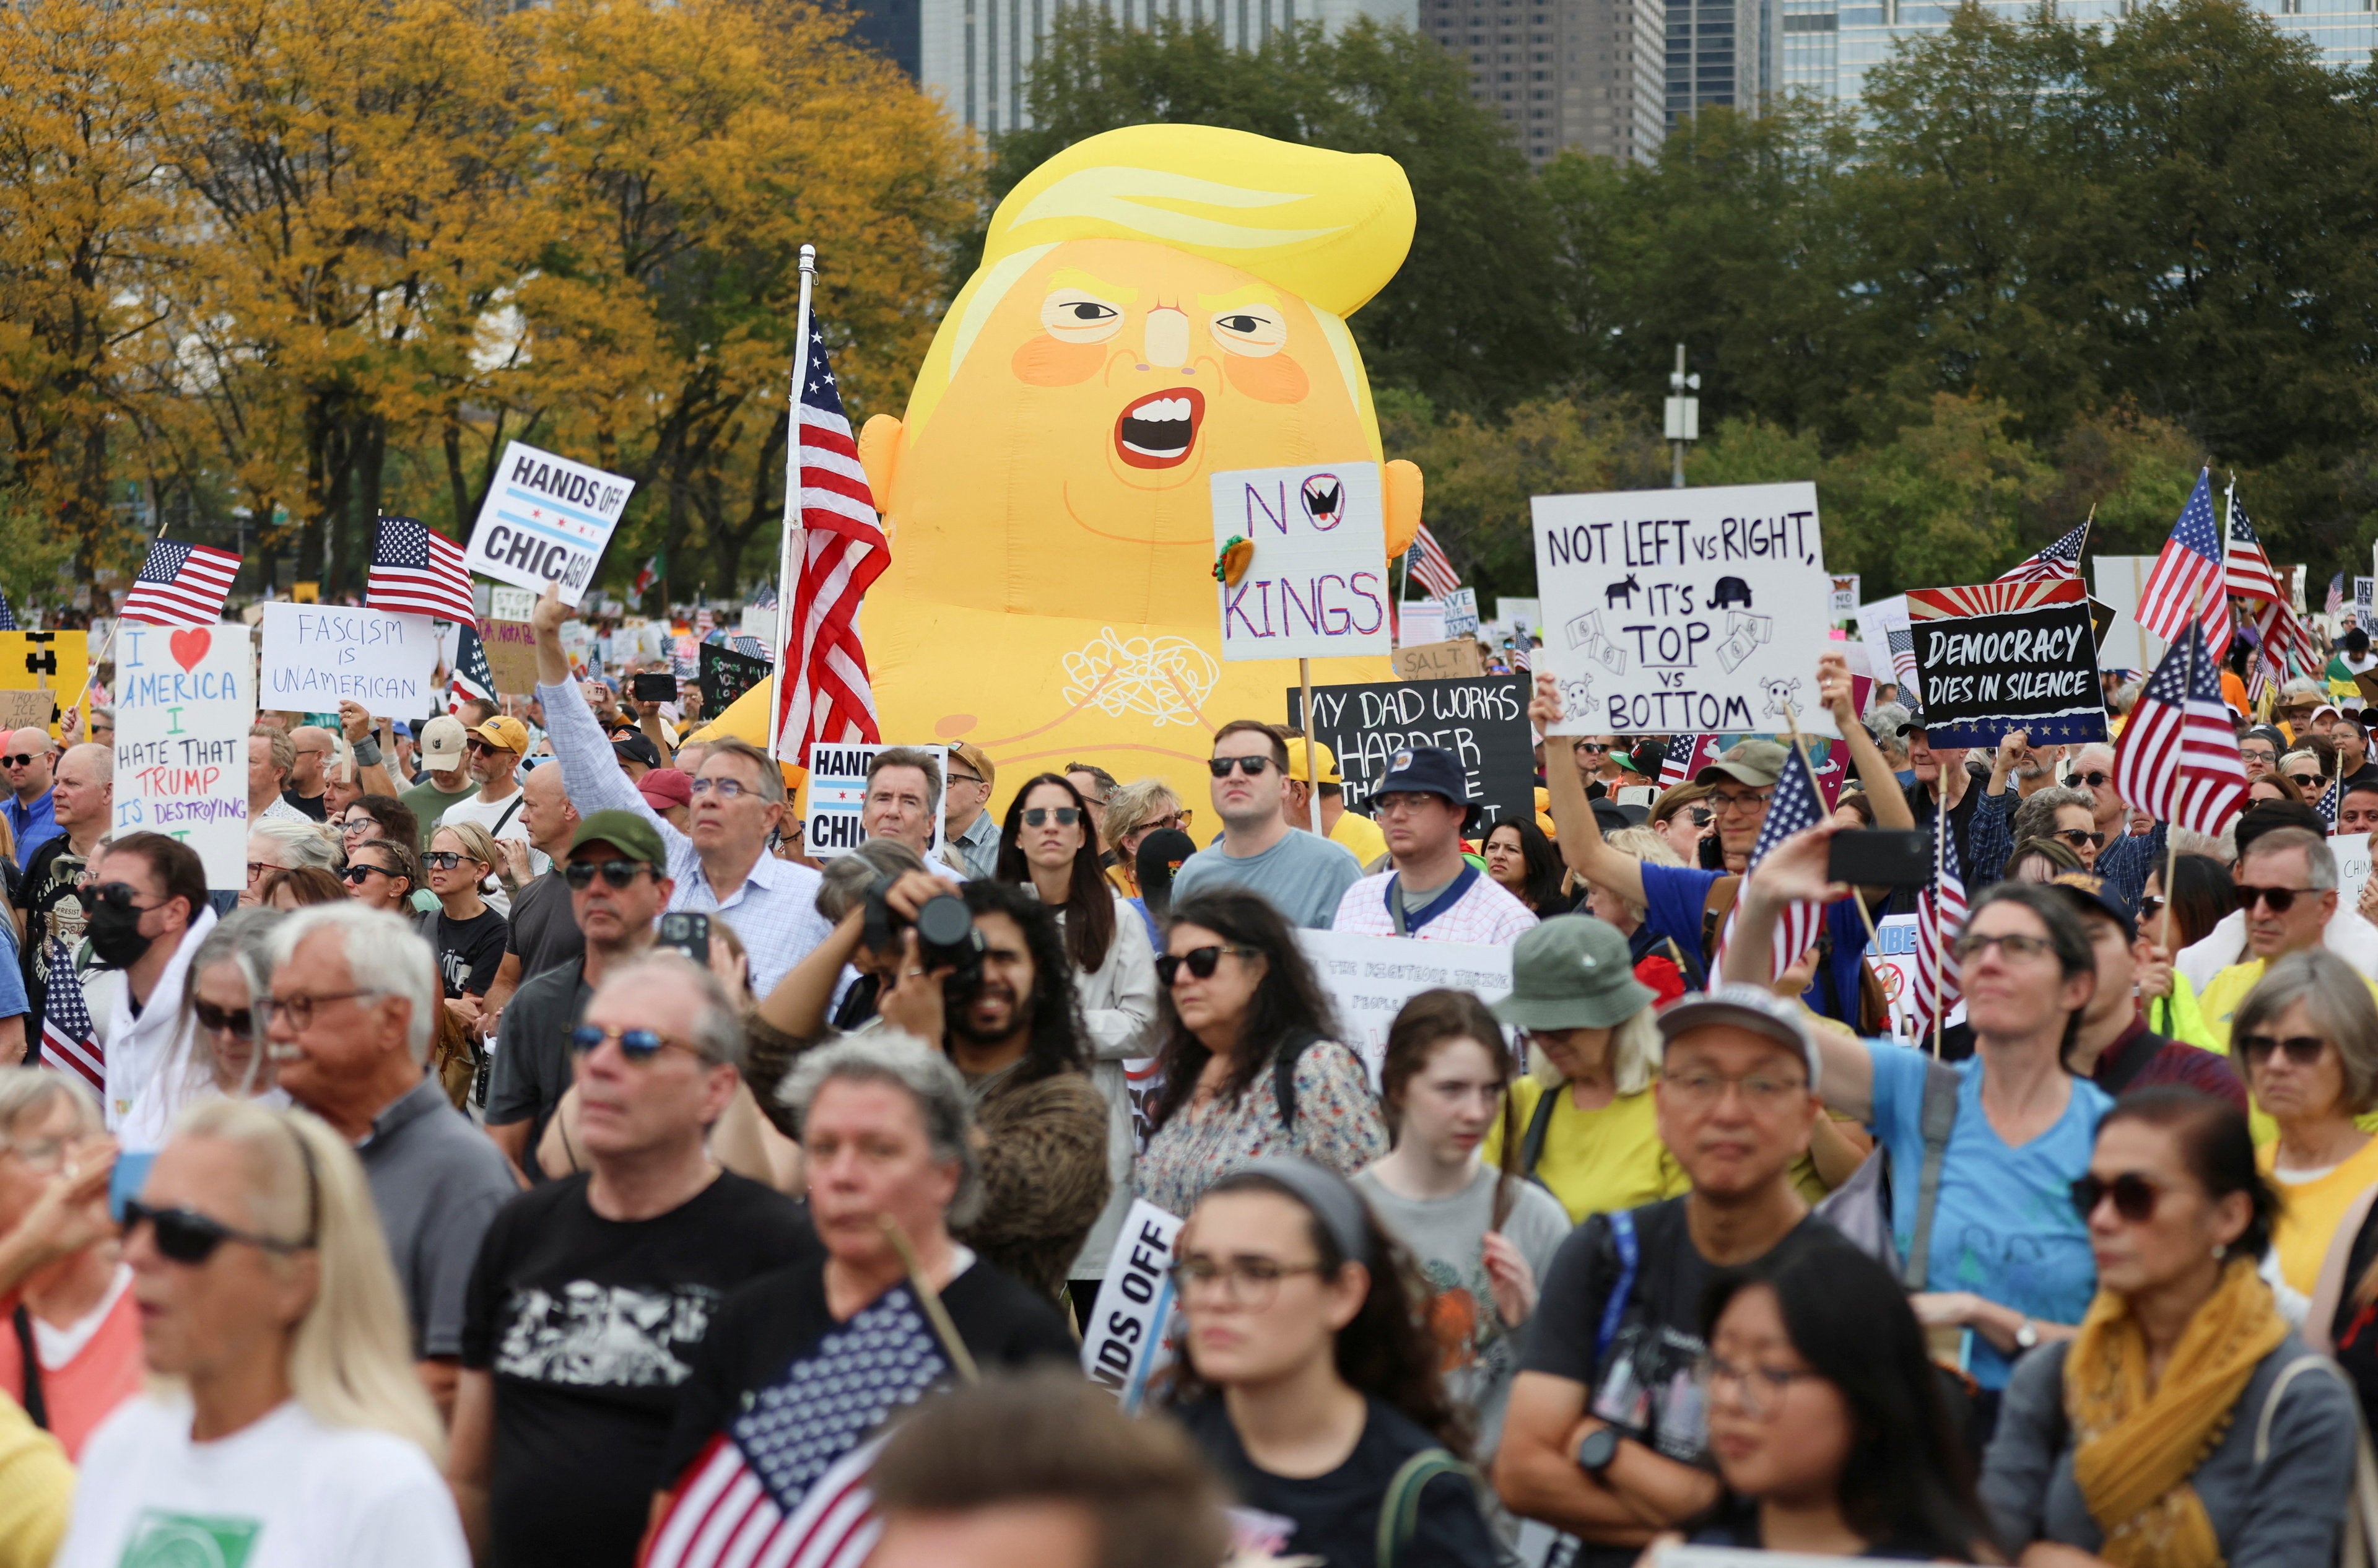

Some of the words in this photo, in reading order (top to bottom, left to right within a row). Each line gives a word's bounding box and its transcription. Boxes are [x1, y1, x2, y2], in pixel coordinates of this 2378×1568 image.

[511, 455, 600, 508] HANDS
[599, 486, 624, 516] OFF
[1245, 473, 1345, 538] NO
[485, 525, 592, 589] CHICAGO
[1548, 523, 1613, 566] NOT
[1624, 520, 1691, 567] LEFT
[1722, 512, 1815, 566] RIGHT,
[1225, 572, 1383, 640] KINGS
[1648, 583, 1694, 616] IT'S
[298, 614, 403, 645] FASCISM
[1622, 622, 1710, 665] TOP
[1923, 624, 2083, 669] DEMOCRACY
[126, 632, 146, 667] I
[339, 647, 355, 665] IS
[120, 672, 237, 708] AMERICA
[273, 665, 416, 699] UNAMERICAN
[1928, 675, 1975, 706] DIES
[1978, 673, 2001, 702] IN
[2004, 669, 2090, 702] SILENCE
[12, 705, 36, 716] ICE
[167, 707, 186, 734] I
[1299, 692, 1347, 731] MY
[1359, 688, 1425, 729] DAD
[1433, 685, 1520, 721] WORKS
[1608, 691, 1753, 729] BOTTOM
[119, 739, 169, 769] HATE
[178, 739, 237, 765] THAT
[136, 766, 220, 797] TRUMP
[118, 798, 143, 828] IS
[154, 797, 246, 824] DESTROYING
[56, 907, 80, 916] #RESIST
[1330, 960, 1357, 976] THE
[1365, 962, 1448, 984] RIGHTEOUS
[1455, 969, 1509, 990] THRIVE
[1352, 995, 1400, 1012] PEOPLE
[1121, 1219, 1170, 1305] OFF
